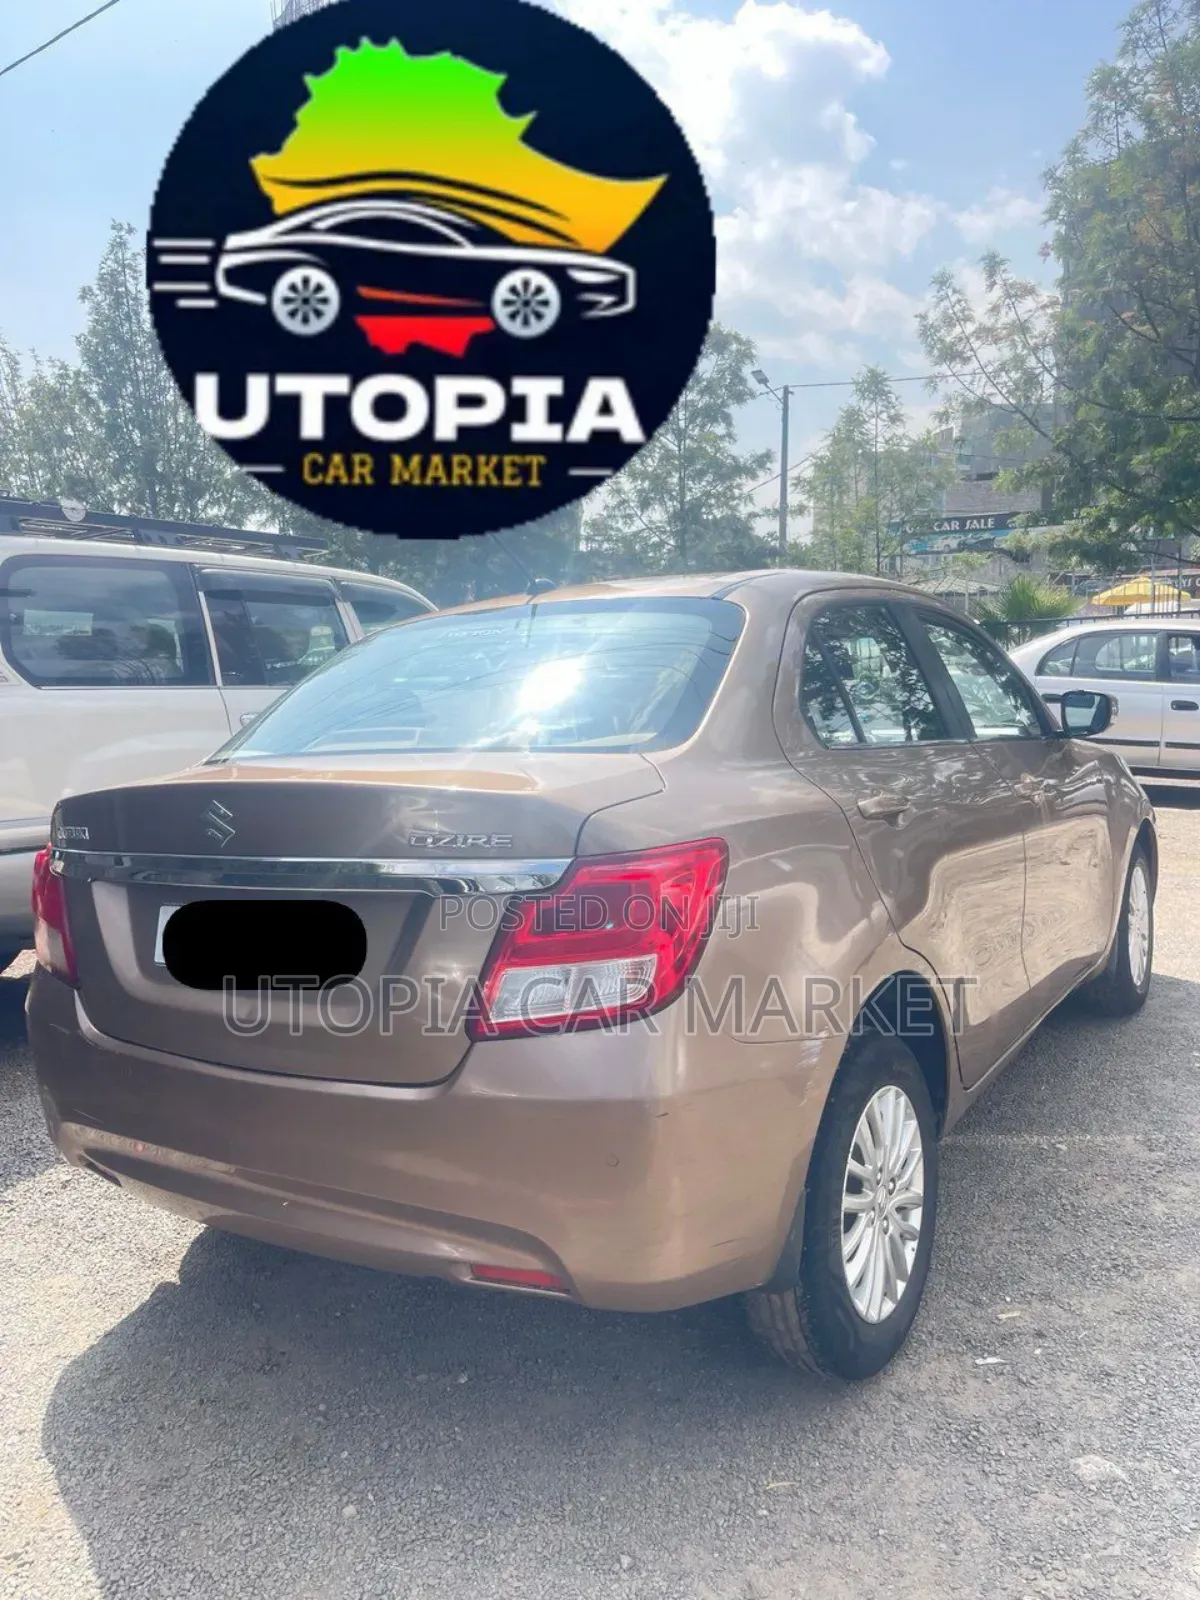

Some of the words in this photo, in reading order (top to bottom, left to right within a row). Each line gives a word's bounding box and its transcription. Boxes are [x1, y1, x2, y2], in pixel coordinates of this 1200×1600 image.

[933, 520, 960, 532] CAR
[964, 518, 995, 530] SALE
[409, 832, 513, 848] DZIRE
